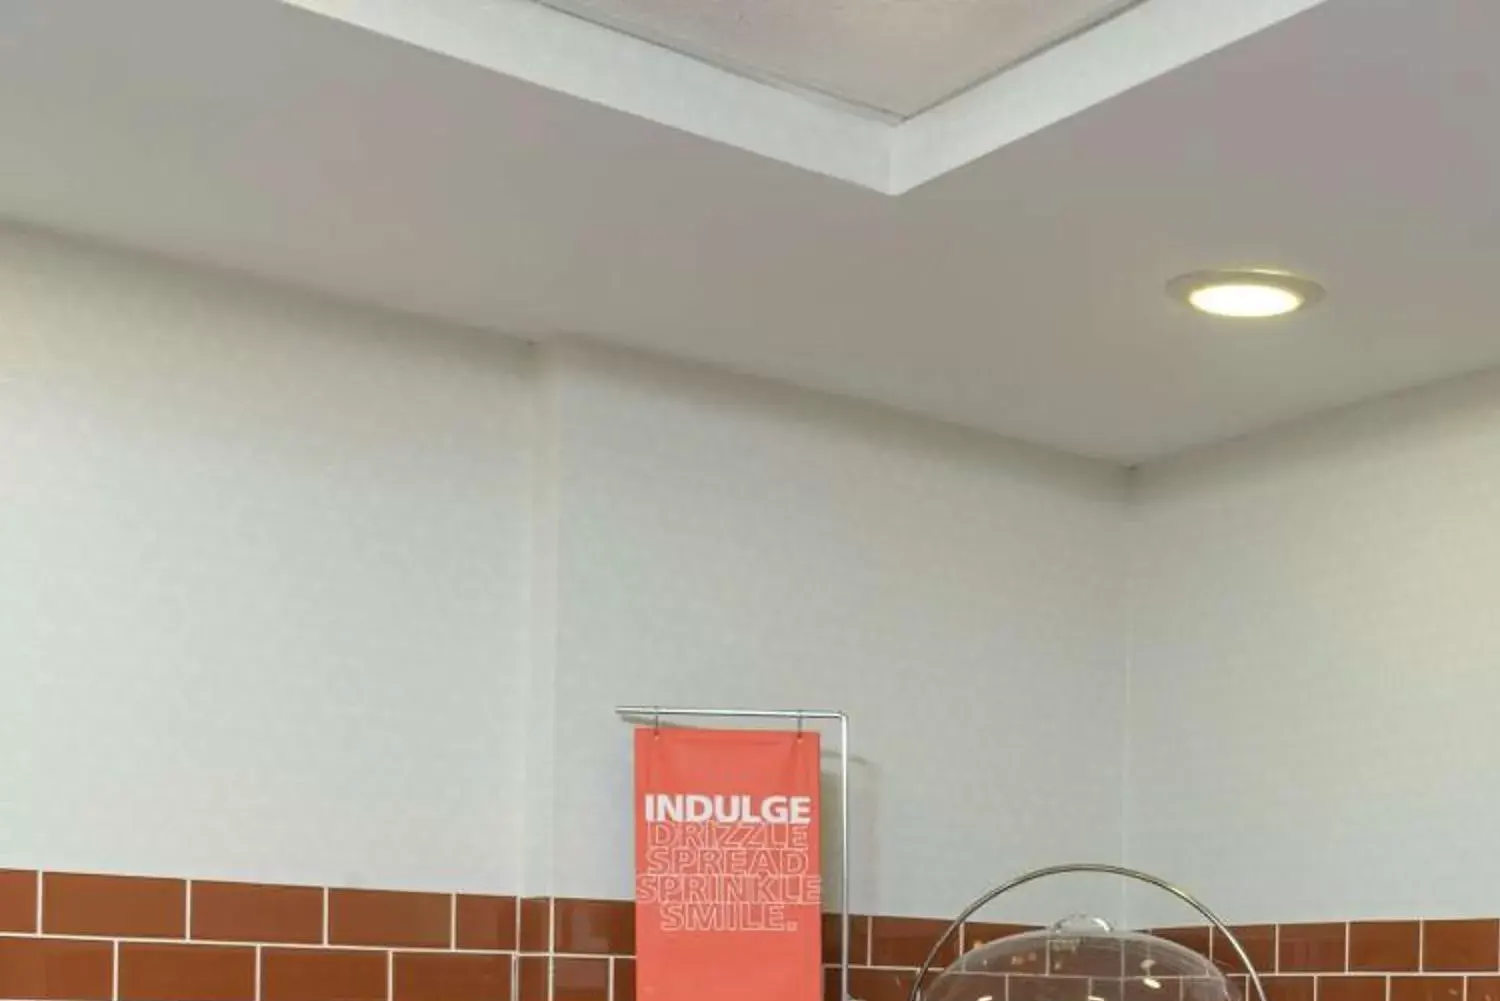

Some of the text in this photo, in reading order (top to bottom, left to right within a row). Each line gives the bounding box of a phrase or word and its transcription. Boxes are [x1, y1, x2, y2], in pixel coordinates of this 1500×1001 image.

[644, 794, 811, 823] INDULGE
[647, 821, 809, 850] DRIZZLE
[646, 847, 809, 875] SPREAD
[636, 873, 822, 905] SPRINKLE
[660, 902, 798, 931] SMILE.
